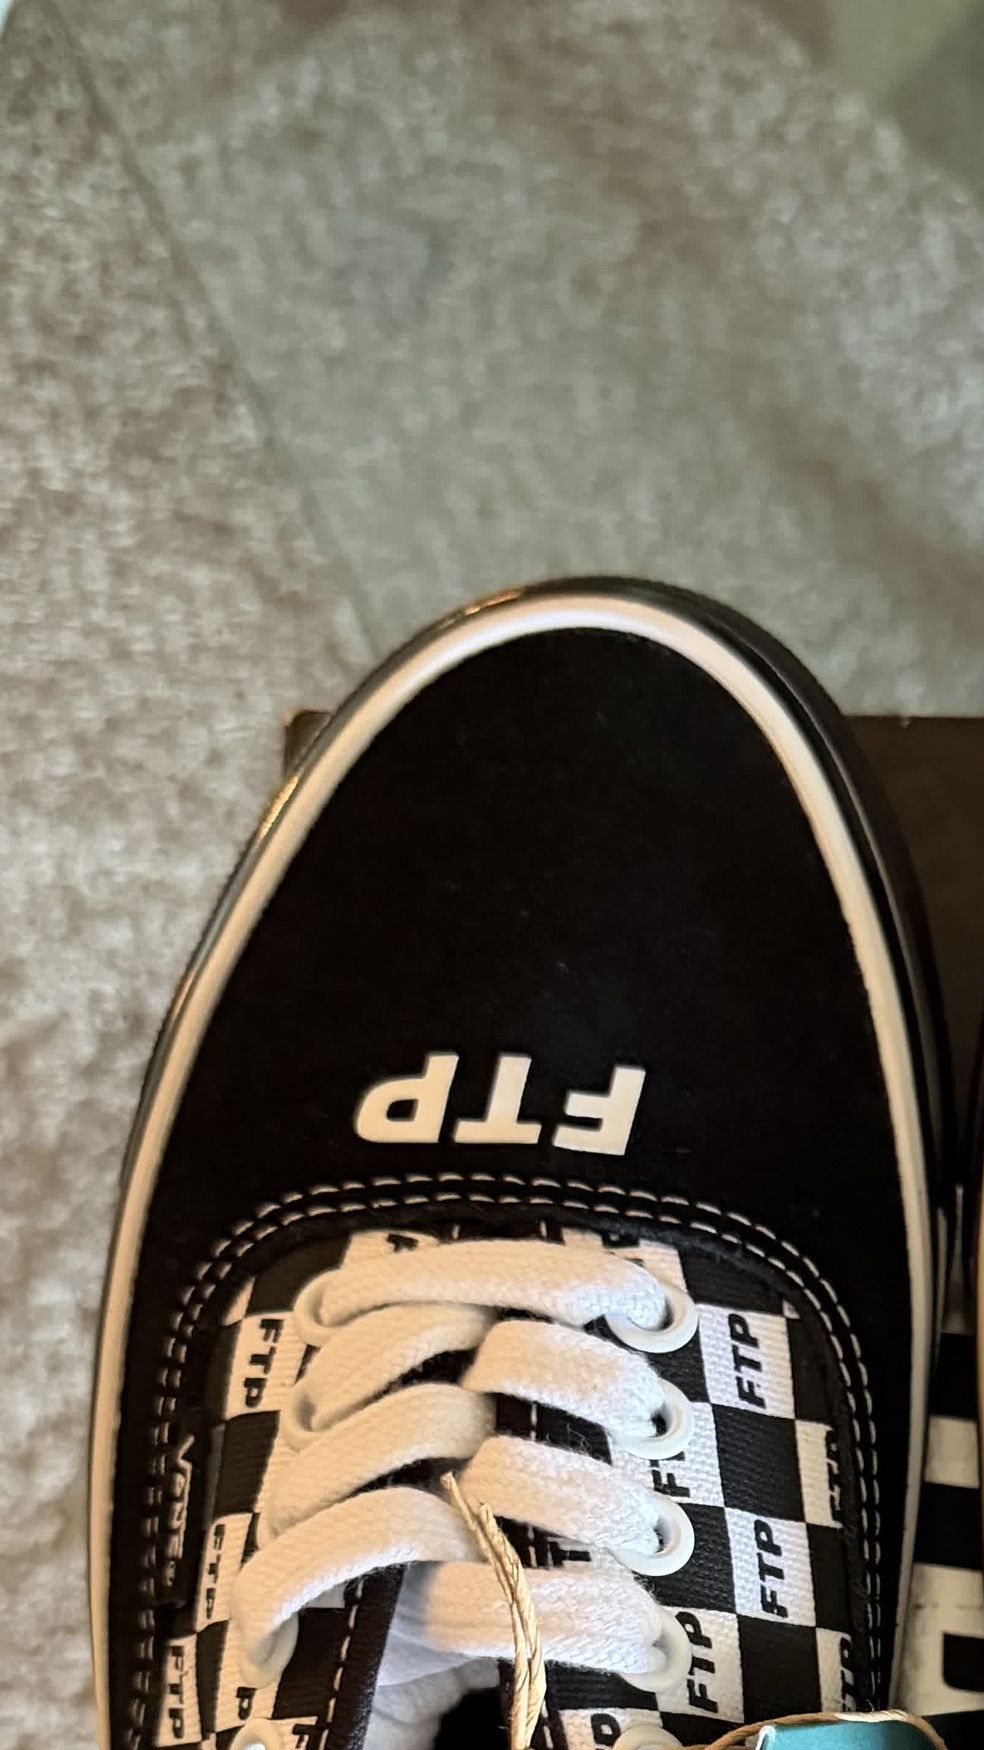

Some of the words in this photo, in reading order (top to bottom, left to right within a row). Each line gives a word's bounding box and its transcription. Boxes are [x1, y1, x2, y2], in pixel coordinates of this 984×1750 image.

[353, 1052, 646, 1156] FTP
[243, 1318, 285, 1408] FTP
[728, 1312, 767, 1409] FTP
[753, 1519, 790, 1618] FTP
[168, 1645, 187, 1738] FTP
[674, 1611, 719, 1713] FTP
